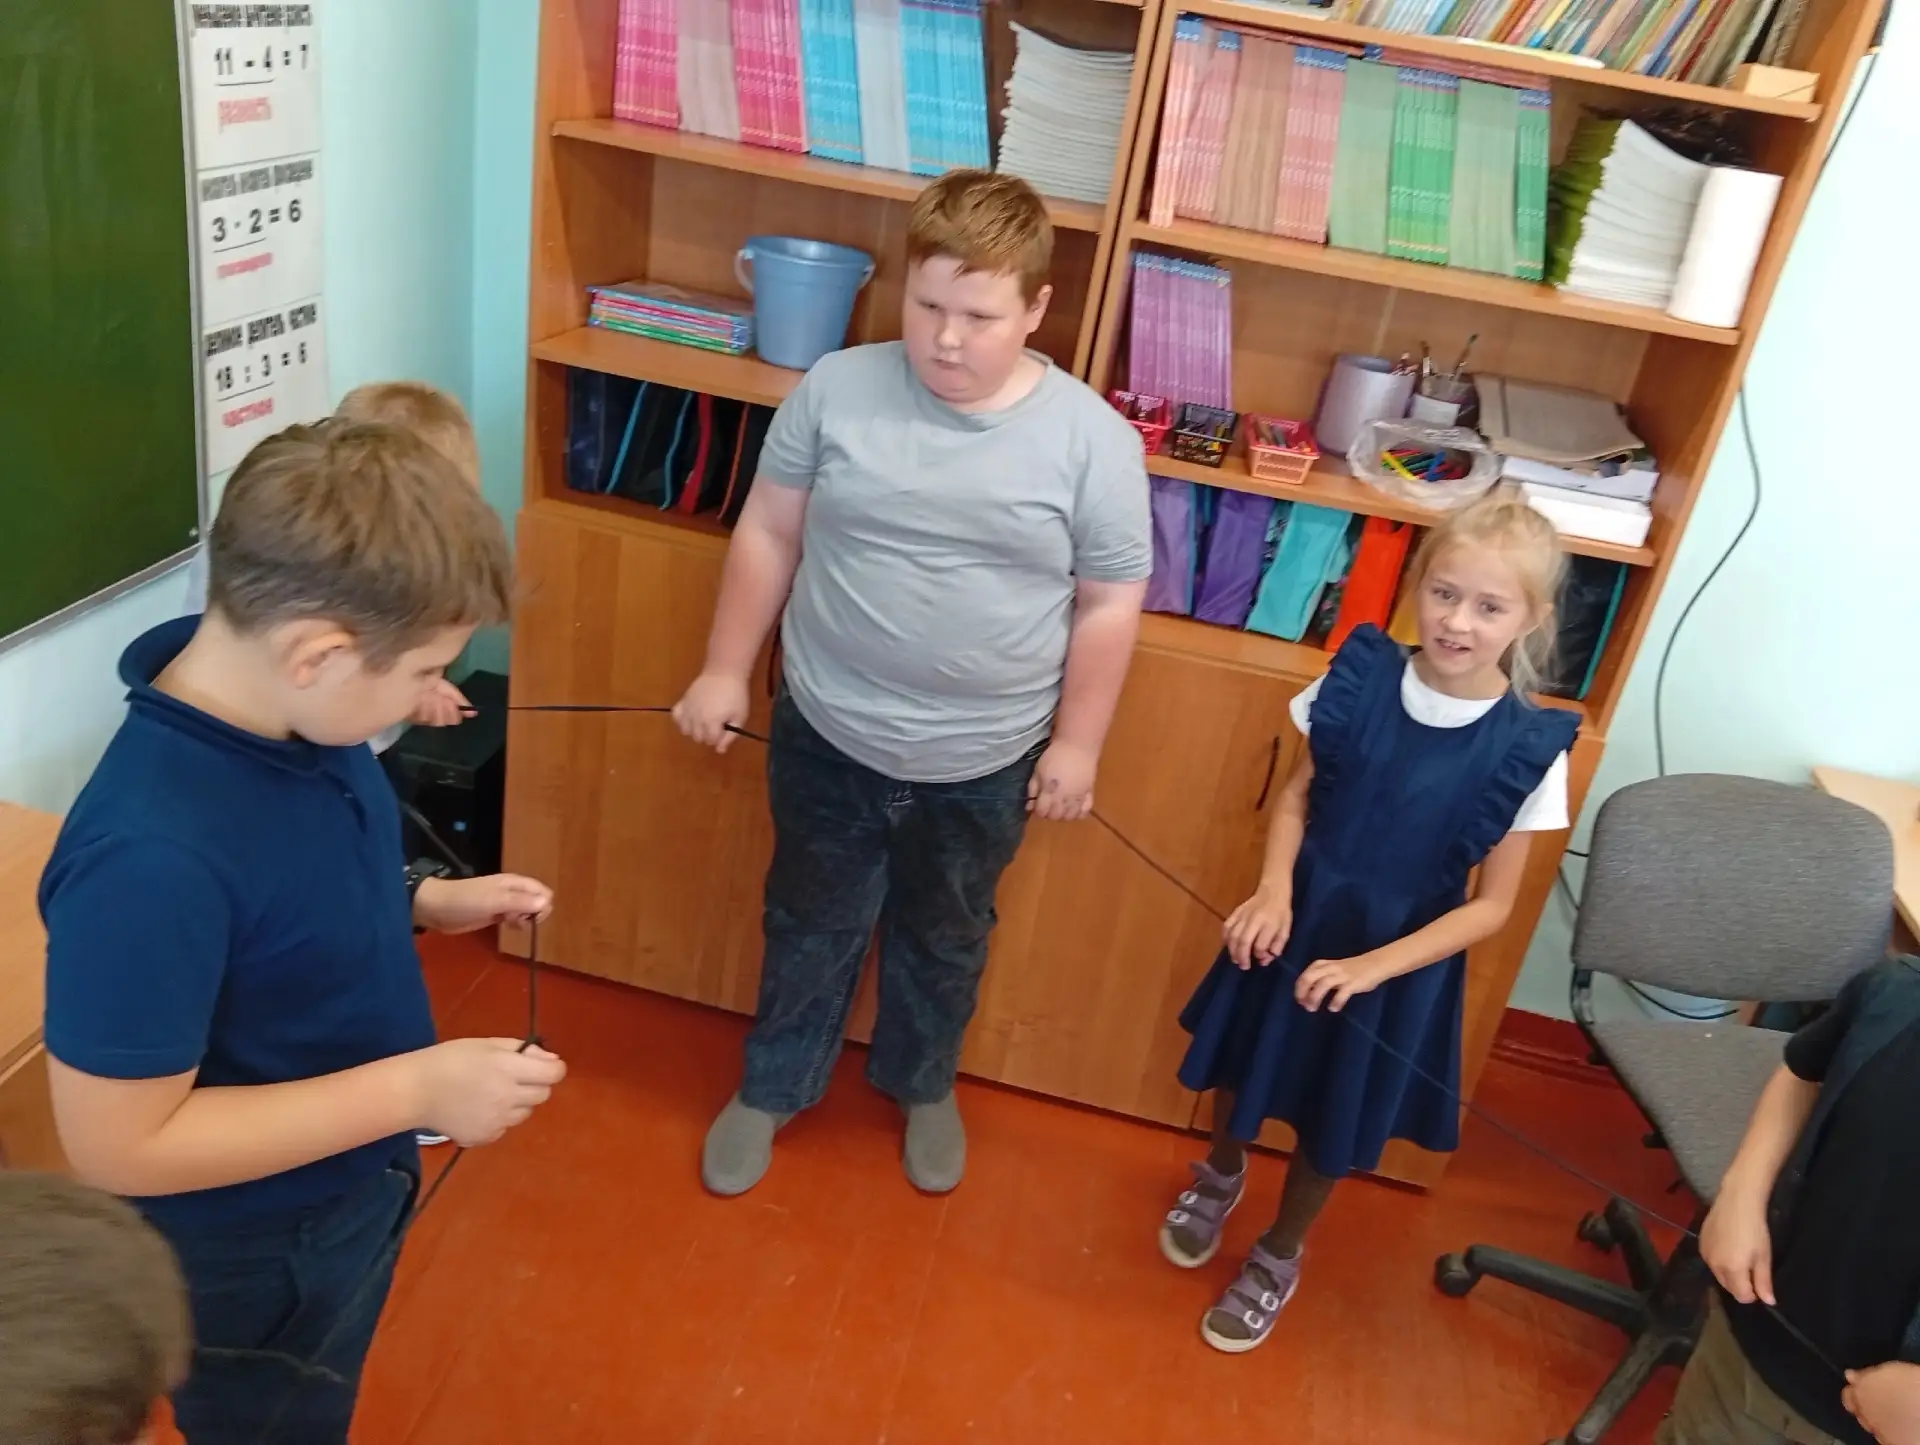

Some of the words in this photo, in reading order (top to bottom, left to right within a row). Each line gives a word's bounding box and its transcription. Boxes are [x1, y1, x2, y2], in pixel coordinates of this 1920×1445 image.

[214, 47, 233, 75] 11
[262, 45, 273, 72] 4
[299, 44, 309, 70] 7
[212, 216, 227, 242] 3
[249, 208, 263, 234] 2
[268, 207, 282, 223] =
[289, 198, 302, 223] 6
[215, 365, 234, 392] 18
[261, 353, 272, 377] 3
[298, 341, 308, 364] 6
